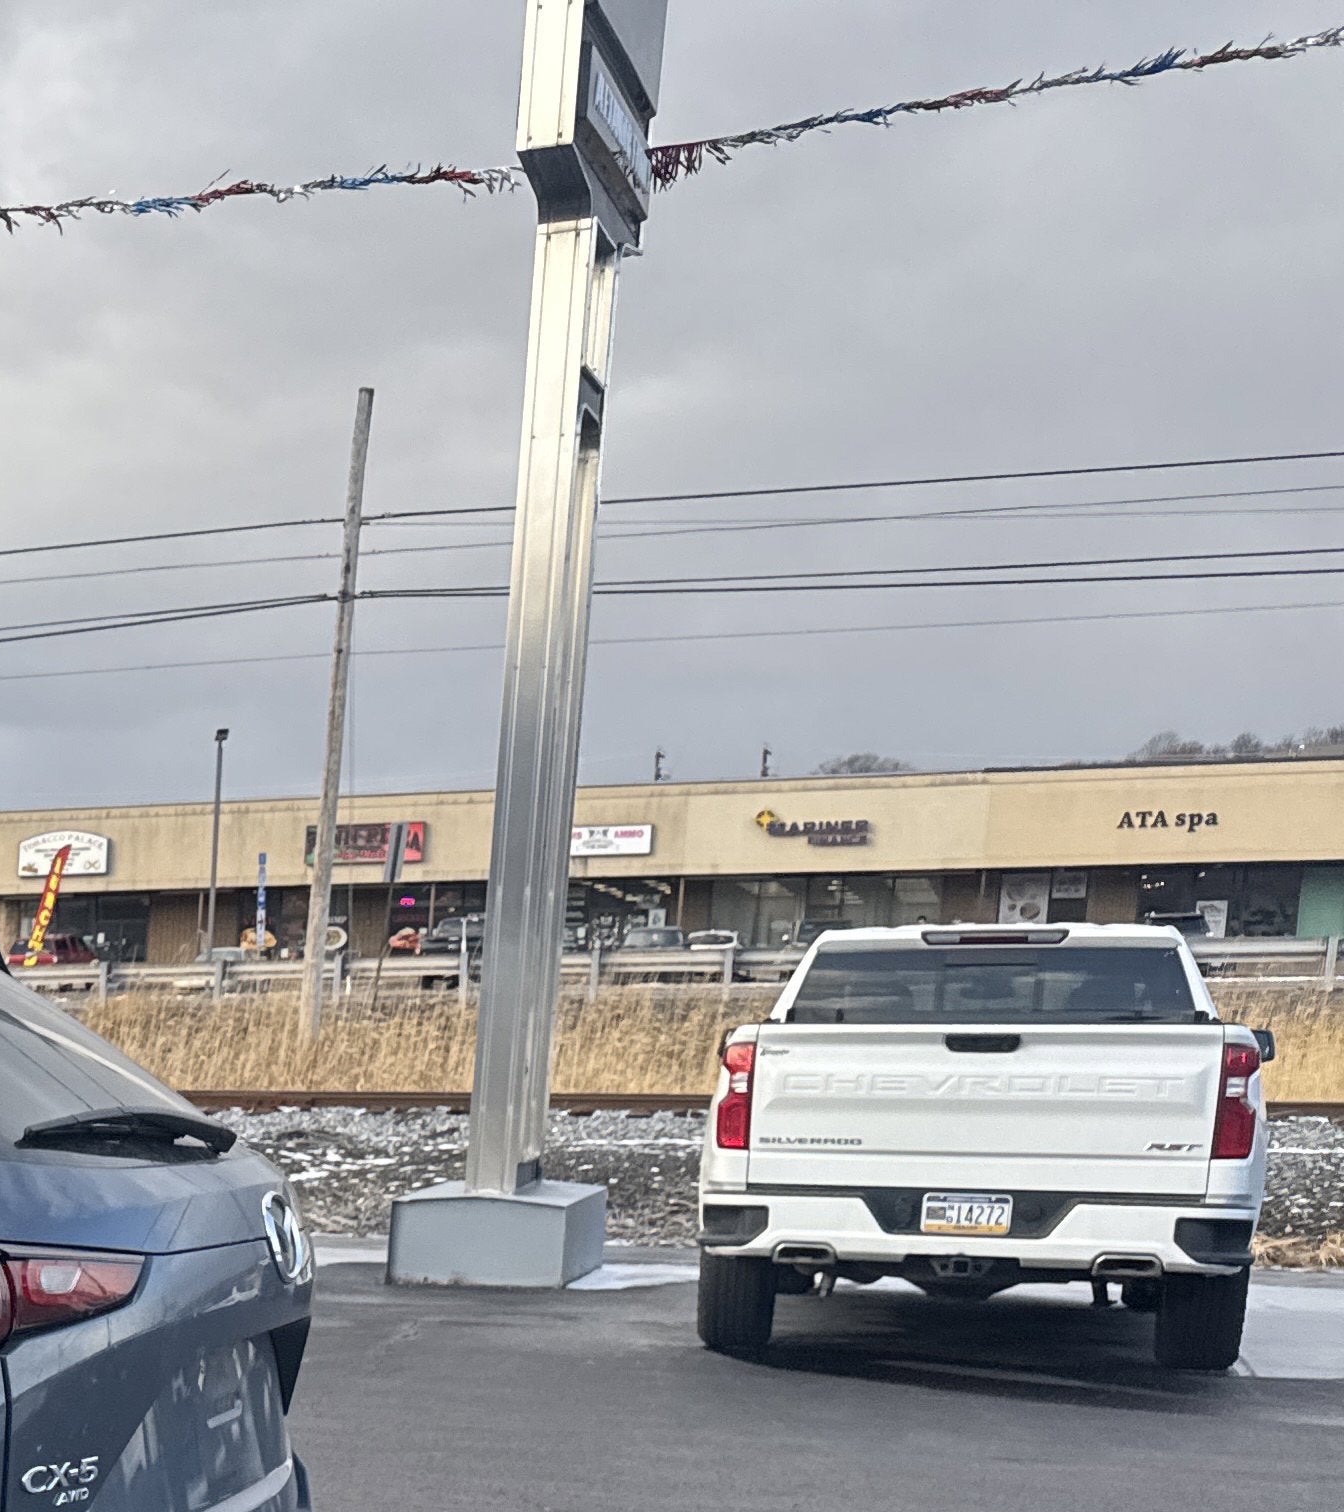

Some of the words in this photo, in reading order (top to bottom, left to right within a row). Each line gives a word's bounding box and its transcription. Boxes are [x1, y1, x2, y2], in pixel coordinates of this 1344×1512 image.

[768, 819, 869, 837] MARINER
[1116, 810, 1169, 829] ATA
[1175, 812, 1219, 833] spa
[614, 829, 644, 839] AMMO
[782, 1074, 1186, 1098] CHEVROLET
[759, 1137, 862, 1145] SILVERADO
[955, 1204, 1005, 1226] 14272
[21, 1455, 99, 1494] CX-5
[54, 1487, 90, 1507] AWD
